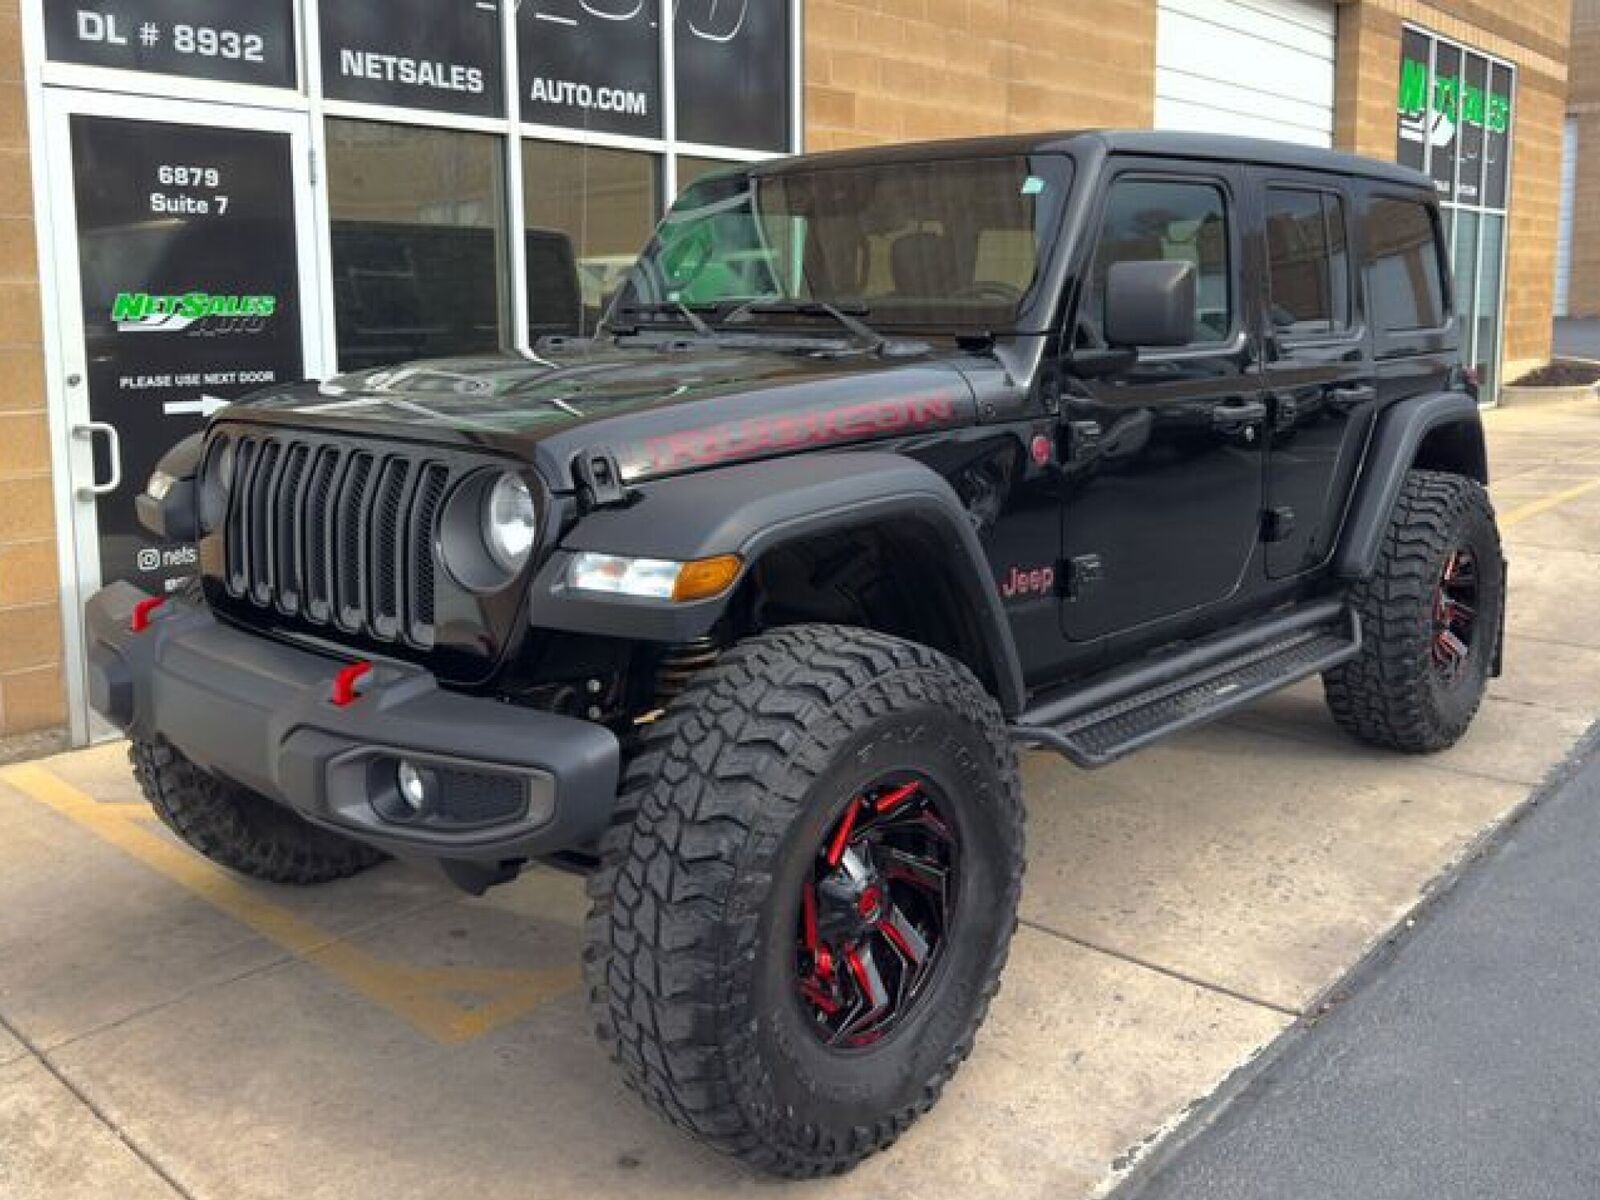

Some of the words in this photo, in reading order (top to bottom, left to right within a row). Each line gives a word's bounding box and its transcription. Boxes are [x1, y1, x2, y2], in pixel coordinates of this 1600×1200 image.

[77, 10, 128, 46] DL
[139, 22, 160, 47] #
[173, 24, 265, 63] 8932
[340, 48, 485, 94] NETSALES
[530, 77, 648, 117] AUTO.COM
[158, 164, 219, 188] 6879
[149, 192, 209, 214] Suite
[214, 195, 229, 216] 7
[119, 375, 171, 390] PLEASE
[174, 373, 201, 387] USE
[204, 371, 237, 385] NEXT
[239, 370, 275, 384] DOOR
[1002, 566, 1055, 598] Jeep
